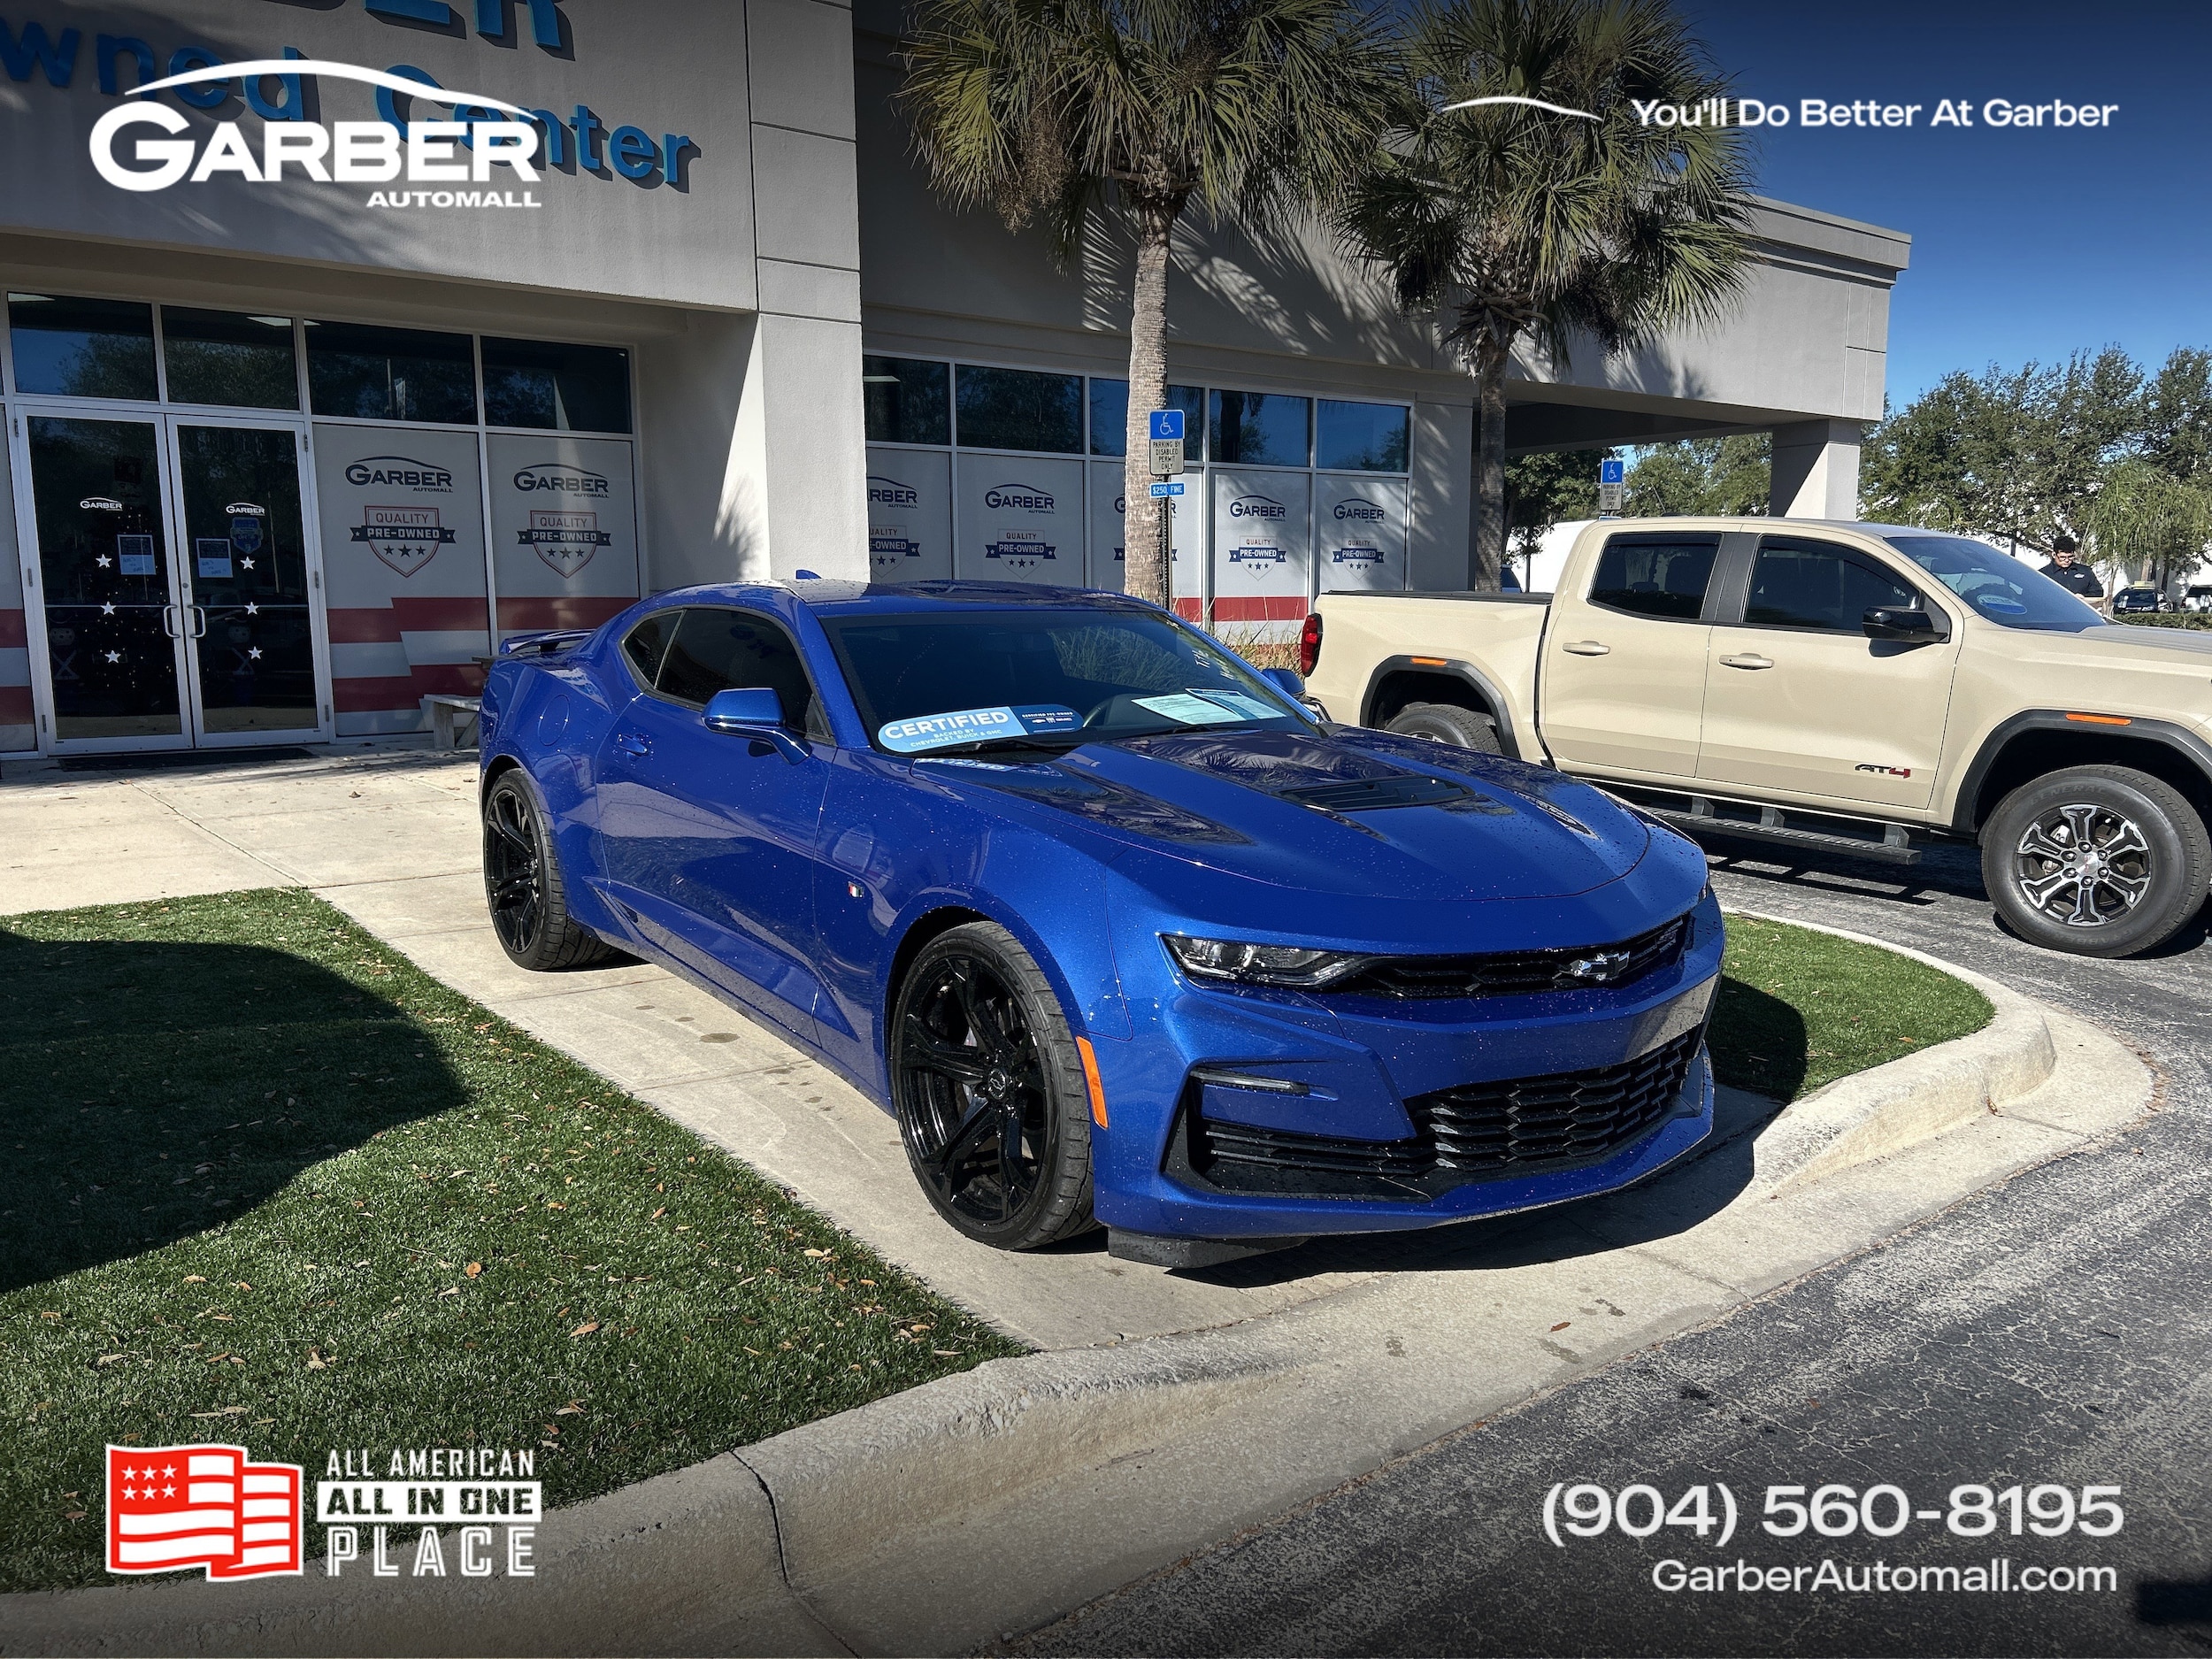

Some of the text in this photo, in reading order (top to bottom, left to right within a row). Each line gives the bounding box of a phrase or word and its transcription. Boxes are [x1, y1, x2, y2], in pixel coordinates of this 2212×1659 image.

[345, 465, 453, 487] GARBER
[513, 472, 609, 492] GARBER
[867, 488, 918, 503] RBER
[985, 490, 1055, 509] GARBER
[226, 505, 265, 514] GARBER
[1230, 502, 1286, 518] GARBER
[1333, 504, 1385, 520] GARBER
[376, 513, 429, 524] QUALITY
[540, 517, 588, 527] QUALITY
[367, 528, 440, 539] PRE-OWNED
[532, 532, 597, 541] PRE-OWNED
[998, 543, 1045, 553] PRE-OWNED
[1240, 549, 1277, 557] PRE-OWNED
[1342, 549, 1377, 558] PRE-OWNED
[885, 711, 1010, 740] CERTIFIED
[1855, 764, 1911, 779] AT4
